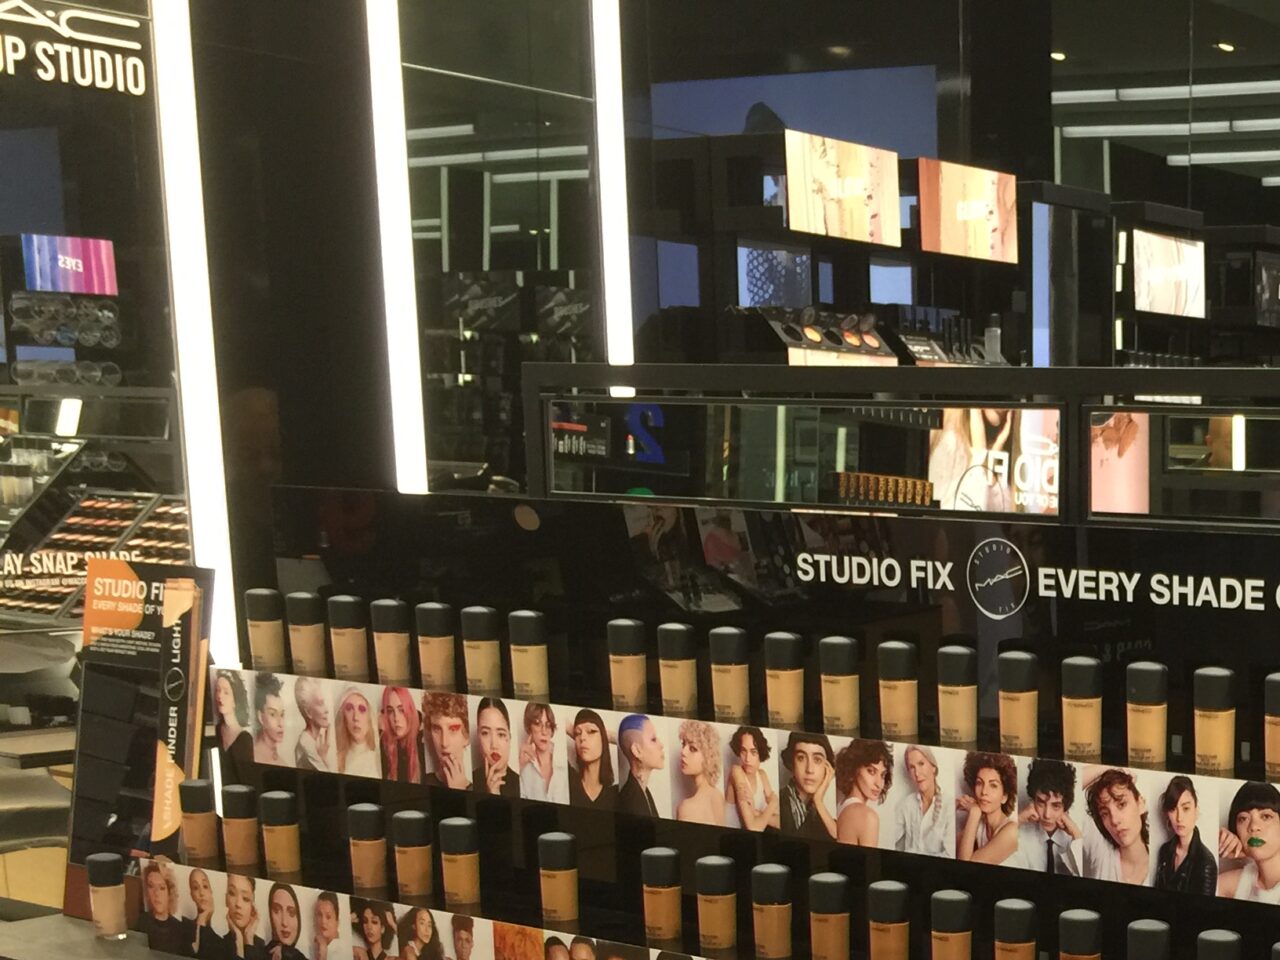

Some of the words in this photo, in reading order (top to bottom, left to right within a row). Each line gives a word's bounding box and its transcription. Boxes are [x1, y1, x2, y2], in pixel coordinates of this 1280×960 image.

[0, 34, 26, 75] P
[35, 41, 146, 96] STUDIO
[0, 553, 24, 575] AY
[29, 552, 79, 574] SNAP
[797, 553, 901, 587] STUDIO
[910, 560, 955, 591] FIX
[92, 600, 116, 611] EVERY
[117, 602, 143, 614] SHADE
[144, 604, 157, 615] OF
[94, 577, 147, 600] STUDIO
[1038, 567, 1141, 603] EVERY
[1149, 573, 1265, 611] SHADE
[167, 705, 178, 764] FINDER
